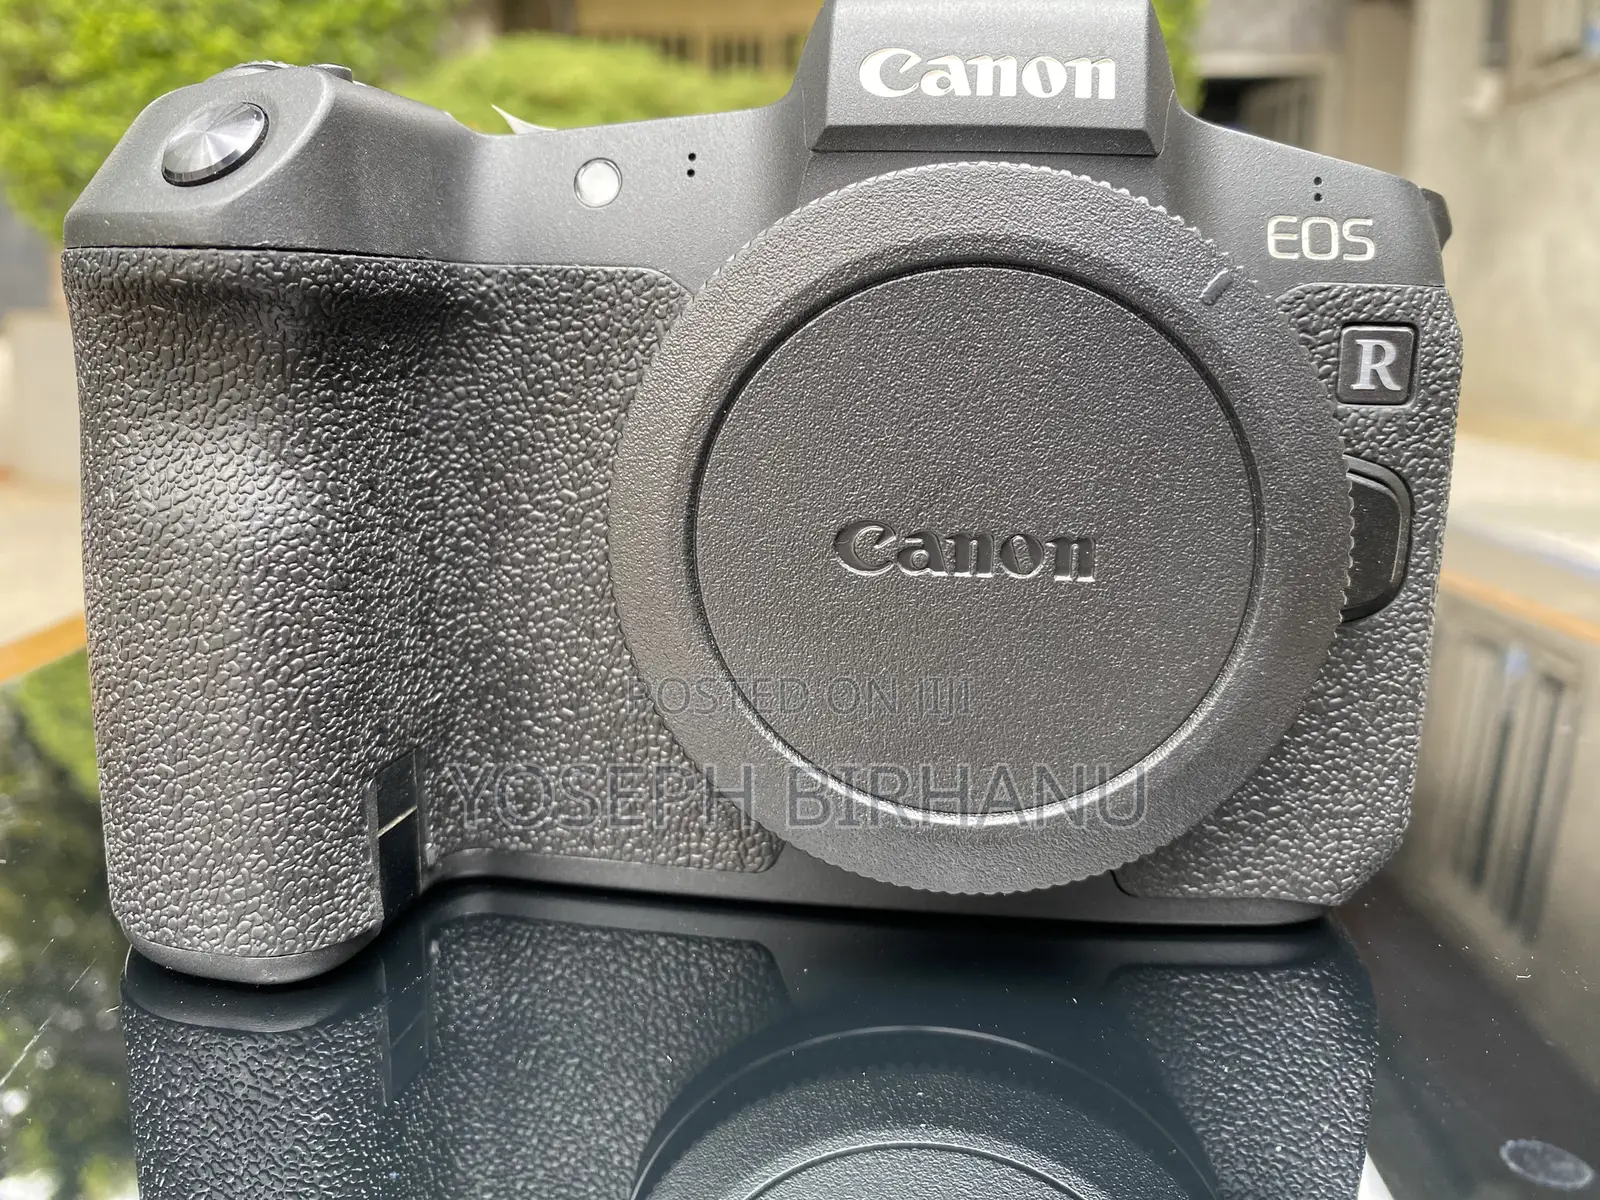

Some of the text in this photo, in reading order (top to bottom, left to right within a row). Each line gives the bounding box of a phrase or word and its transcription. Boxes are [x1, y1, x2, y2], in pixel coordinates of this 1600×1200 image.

[859, 47, 1117, 100] Canon
[1266, 215, 1376, 261] EOS
[1350, 338, 1399, 392] R
[834, 520, 1097, 582] Canon
